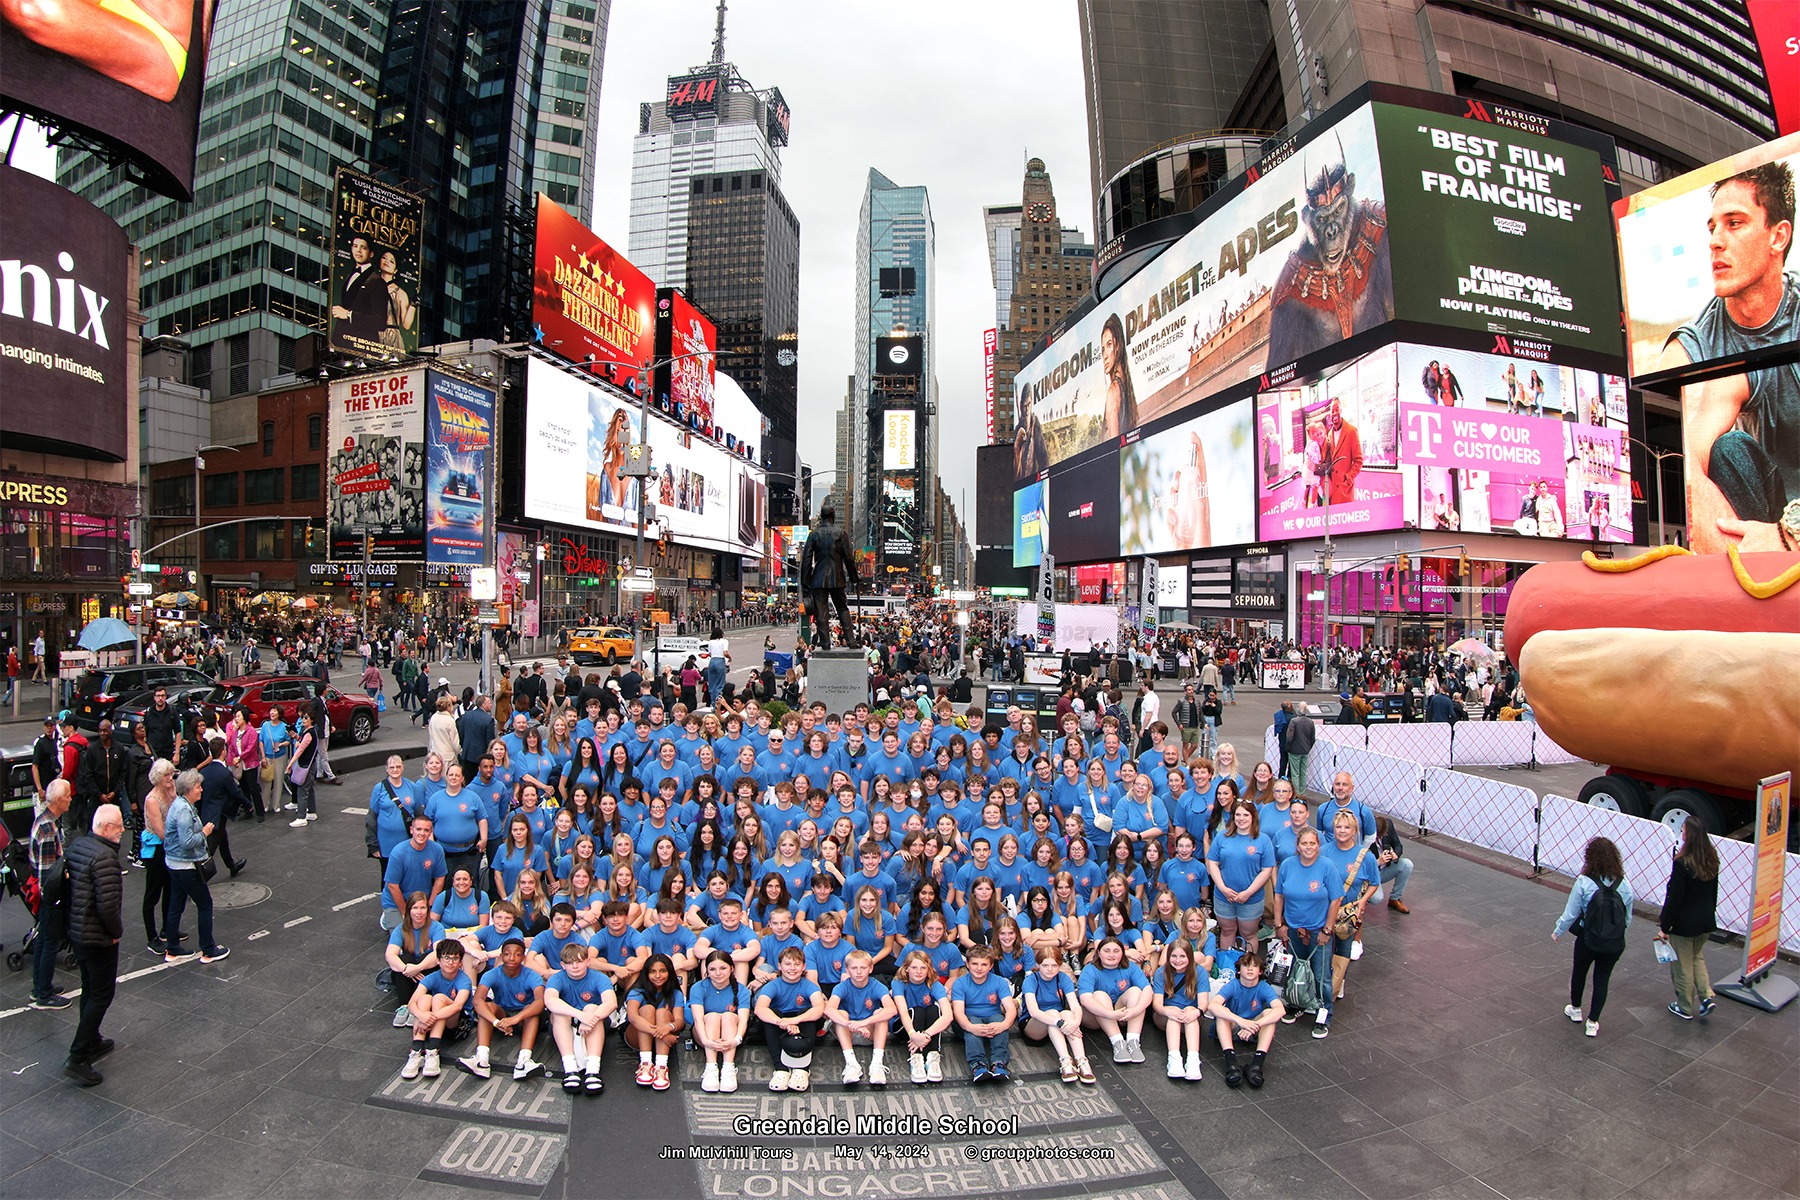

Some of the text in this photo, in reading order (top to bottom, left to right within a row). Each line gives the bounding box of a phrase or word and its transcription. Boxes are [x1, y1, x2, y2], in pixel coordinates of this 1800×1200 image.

[670, 79, 717, 106] H&M
[1494, 107, 1550, 127] MARRIOTT
[1495, 116, 1546, 135] MARQUIS
[1261, 135, 1298, 166] MARRIOTT
[1262, 147, 1294, 175] MARQUIS
[1417, 125, 1566, 177] “BEST FILM
[1455, 155, 1552, 194] OF THE
[1421, 170, 1582, 222] FRANCHISE”
[343, 197, 368, 218] THE
[371, 206, 416, 236] GREAT
[350, 216, 409, 247] GATSBY
[1218, 197, 1299, 282] APES
[1469, 265, 1552, 294] KINGDOM
[554, 255, 644, 337] DAZZLING AND
[1125, 260, 1217, 346] PLANET OF THE
[1457, 276, 1524, 302] PLANET
[1532, 293, 1574, 312] APES
[1440, 297, 1473, 312] NOW
[1475, 303, 1532, 322] PLAYING
[1533, 316, 1551, 326] ONLY
[1558, 320, 1591, 334] THEATERS
[1131, 315, 1187, 357] NOW PLAYING
[1155, 331, 1184, 352] THEATERS
[1513, 339, 1552, 352] MARRIOTT
[1514, 347, 1549, 360] MARQUIS
[54, 353, 105, 385] intimates.
[1033, 341, 1093, 406] KINGDOM
[1271, 362, 1298, 378] MARRIOTT
[1271, 371, 1295, 385] MARQUIS
[351, 375, 409, 398] BEST OF
[434, 383, 455, 396] MUSICAL
[475, 397, 493, 409] HISTORY
[451, 383, 461, 391] TIME
[462, 386, 467, 394] TO
[467, 389, 486, 401] CHANGE
[344, 391, 414, 413] THE YEAR!
[434, 394, 490, 430] BACK
[441, 422, 490, 445] TO FUTURE
[662, 392, 755, 461] BROADWAY
[888, 414, 899, 449] Loose
[900, 414, 910, 466] Knocked
[1452, 420, 1478, 439] WE
[1500, 425, 1531, 445] OUR
[1453, 440, 1541, 466] CUSTOMERS
[335, 469, 363, 483] MERRILY
[1283, 509, 1371, 531] WE OUR CUSTOMERS
[1246, 547, 1269, 555] SEPHORA
[310, 564, 338, 574] GIFTS
[427, 564, 449, 575] GIFTS
[1167, 580, 1177, 594] SF
[1235, 595, 1275, 606] SEPHORA
[33, 602, 66, 611] EXPRESS
[1264, 663, 1305, 671] CHICAGO
[381, 1066, 563, 1119] PALACE
[1088, 1054, 1142, 1116] EIGHTH
[983, 1096, 1115, 1124] ATKINSON
[440, 1126, 560, 1179] CORT
[986, 1130, 1135, 1152] SAMUEL J.
[1147, 1129, 1185, 1164] AVE
[782, 1147, 977, 1171] BARRYMORE
[992, 1142, 1156, 1188] FRIEDMAN
[713, 1169, 989, 1197] LONGACRE
